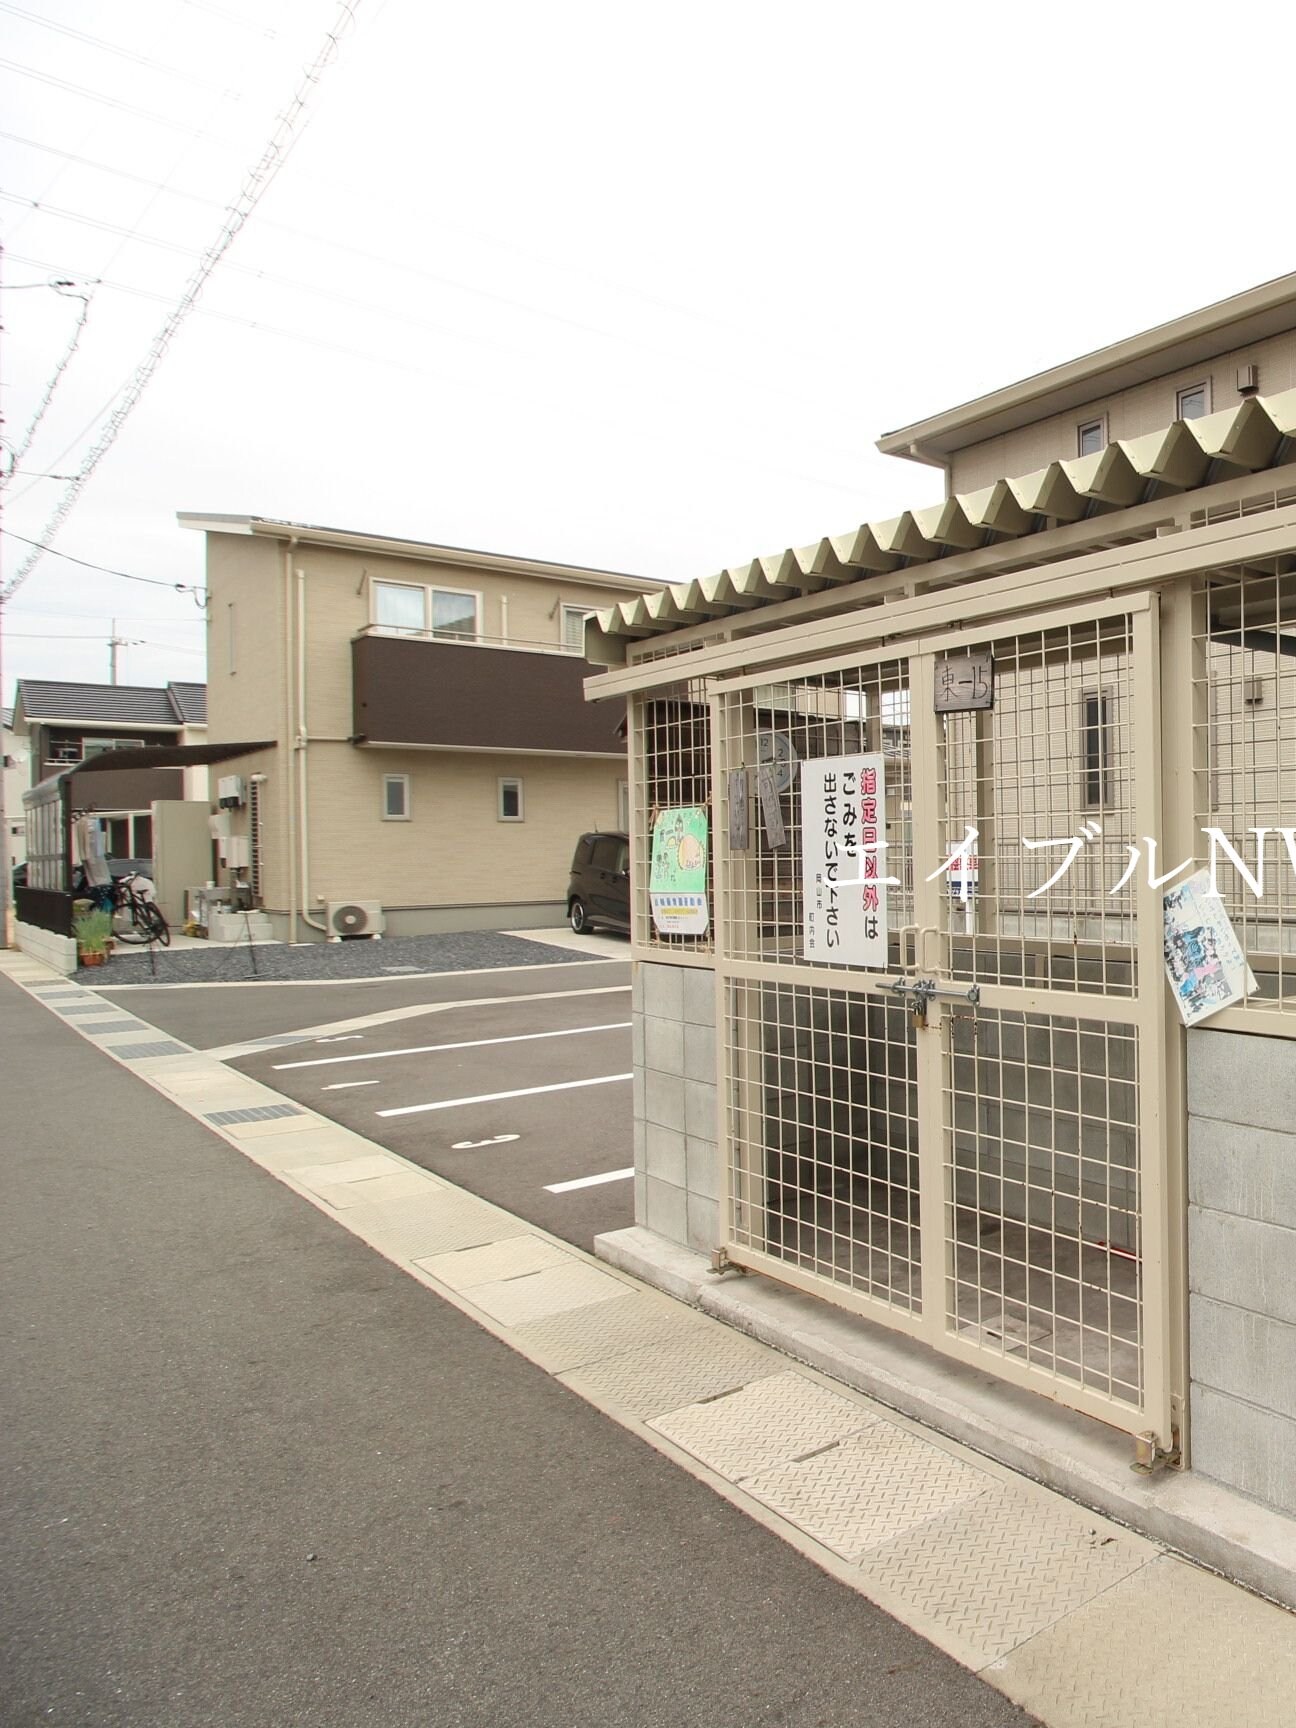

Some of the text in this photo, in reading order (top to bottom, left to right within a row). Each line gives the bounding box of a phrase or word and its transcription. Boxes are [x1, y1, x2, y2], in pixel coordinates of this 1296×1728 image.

[842, 772, 858, 858] ごみを
[451, 1134, 521, 1149] 3
